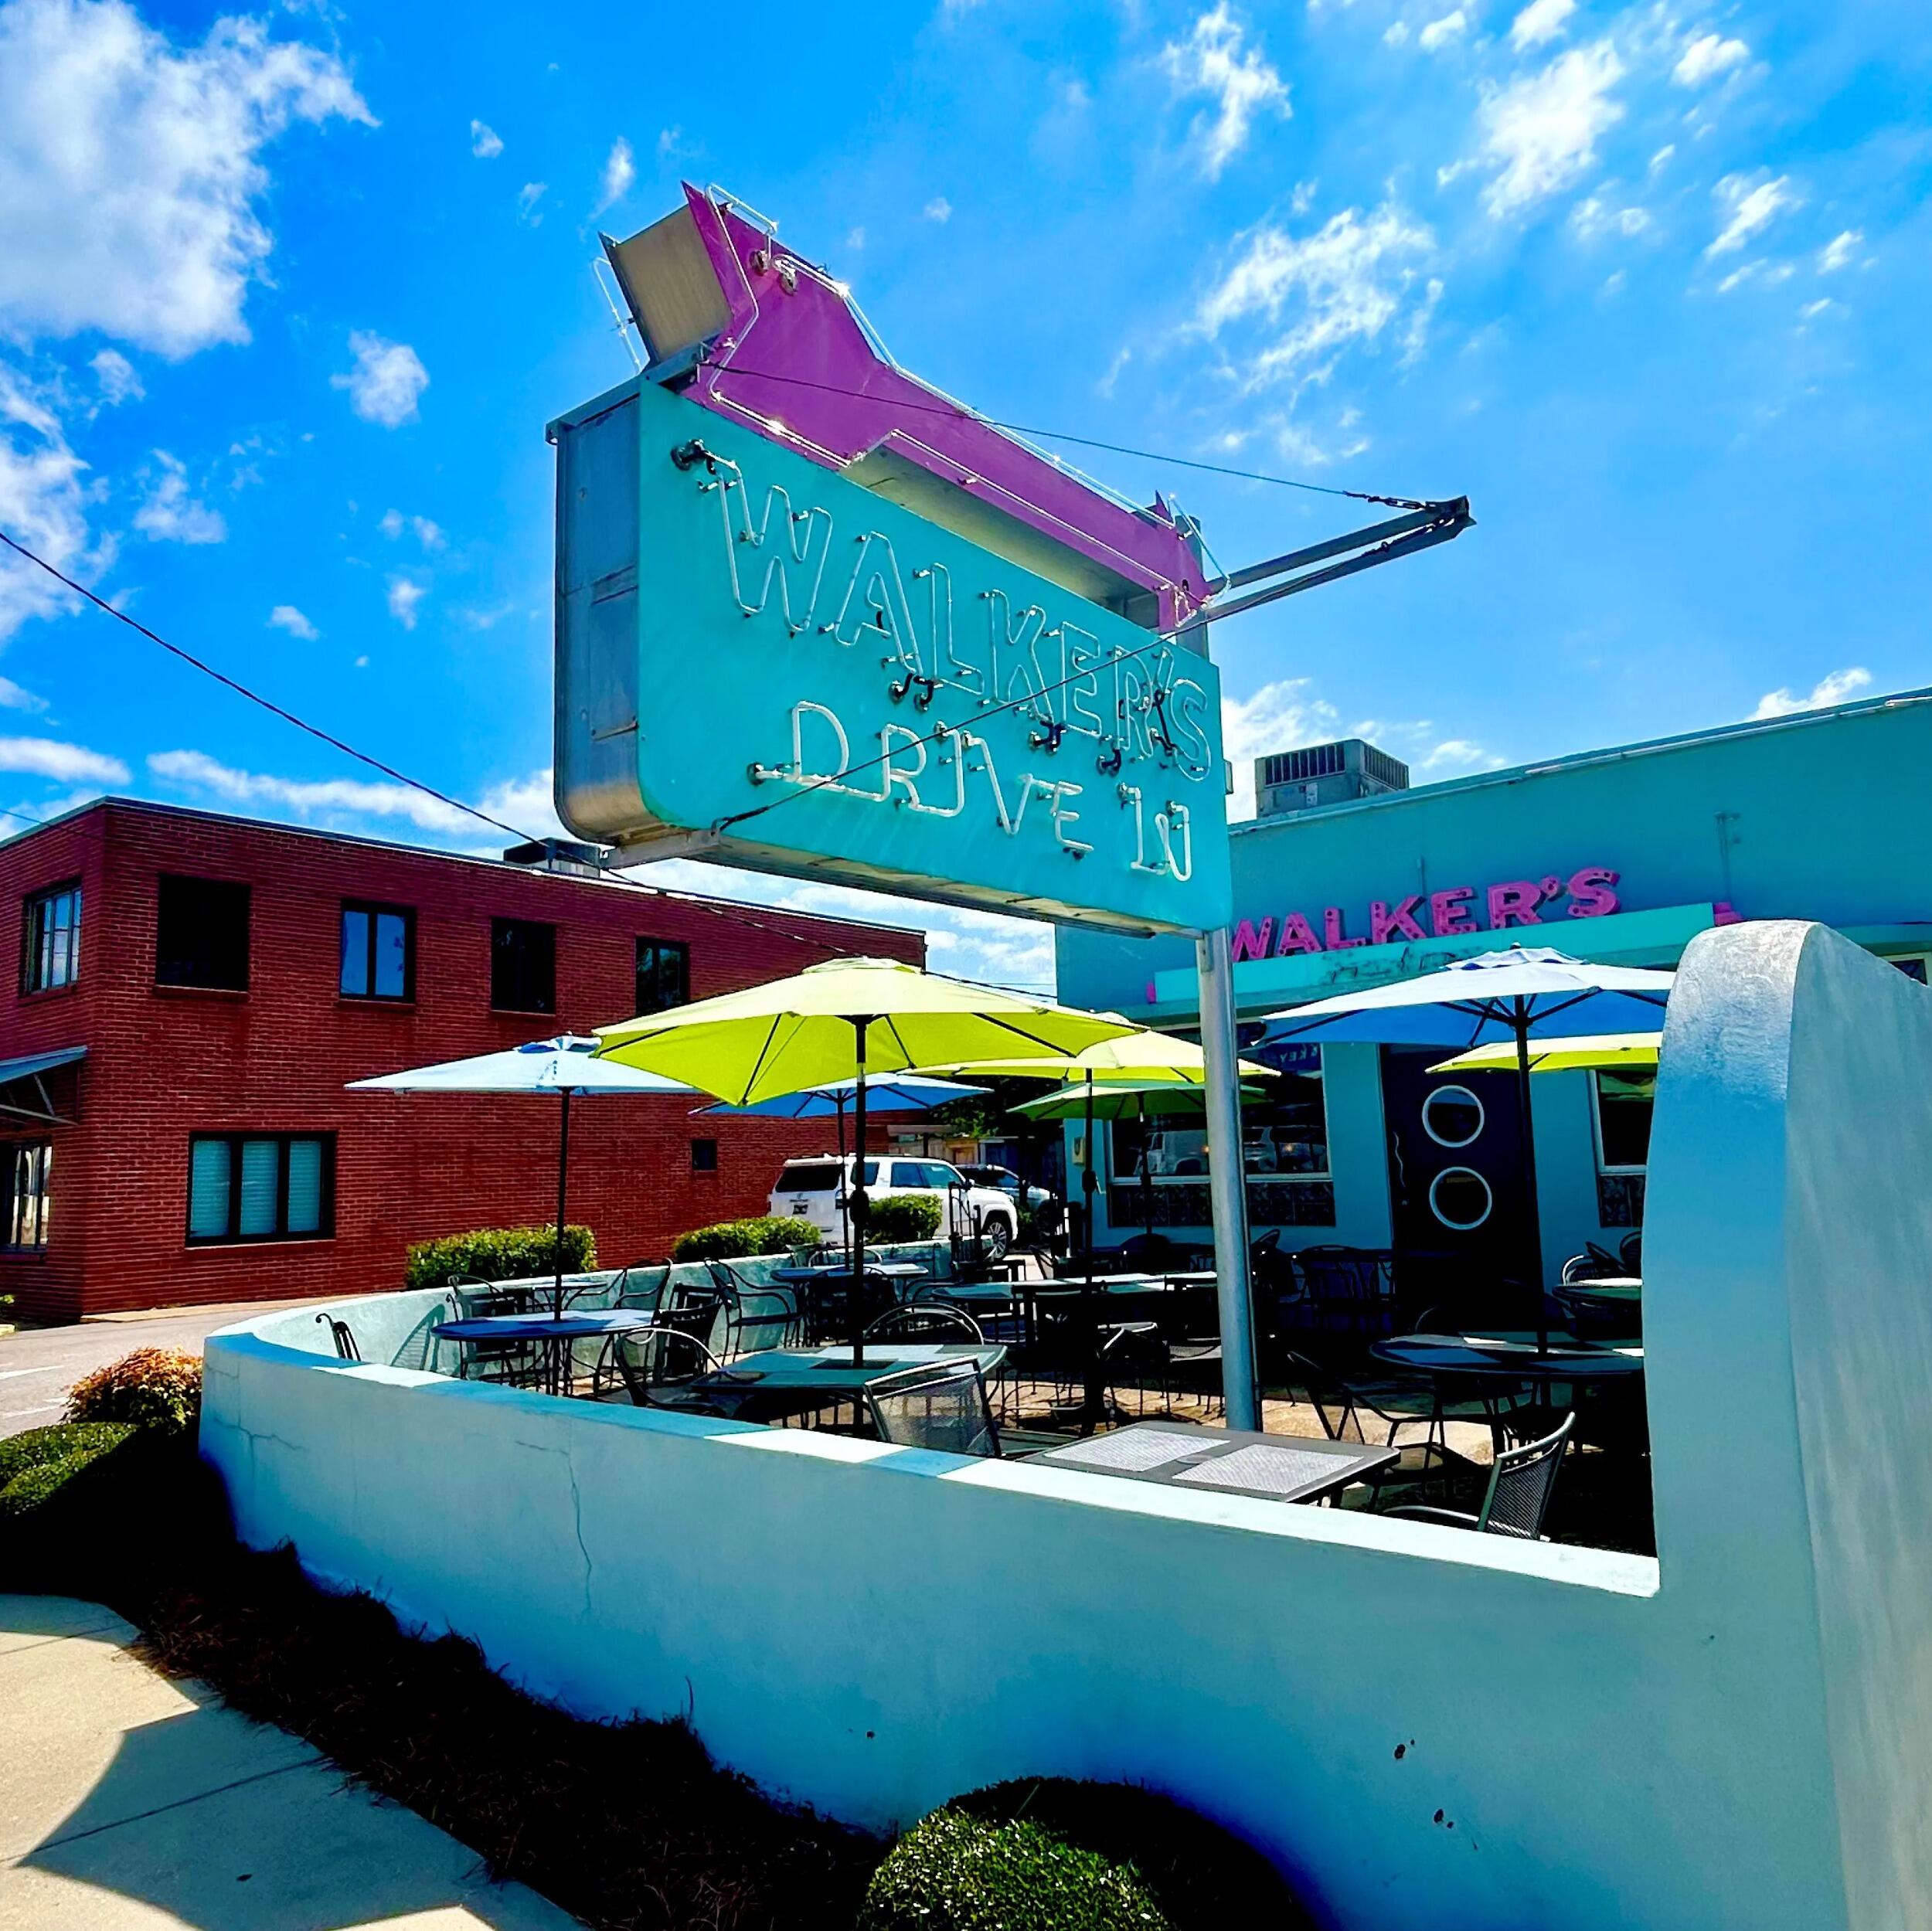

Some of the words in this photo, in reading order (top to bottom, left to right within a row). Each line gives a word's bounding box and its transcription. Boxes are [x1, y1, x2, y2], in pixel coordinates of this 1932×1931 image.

[717, 462, 1211, 782] WALKER'S
[788, 701, 1093, 852] DRIVE
[1130, 784, 1192, 882] IN
[1232, 866, 1621, 962] WALKER'S
